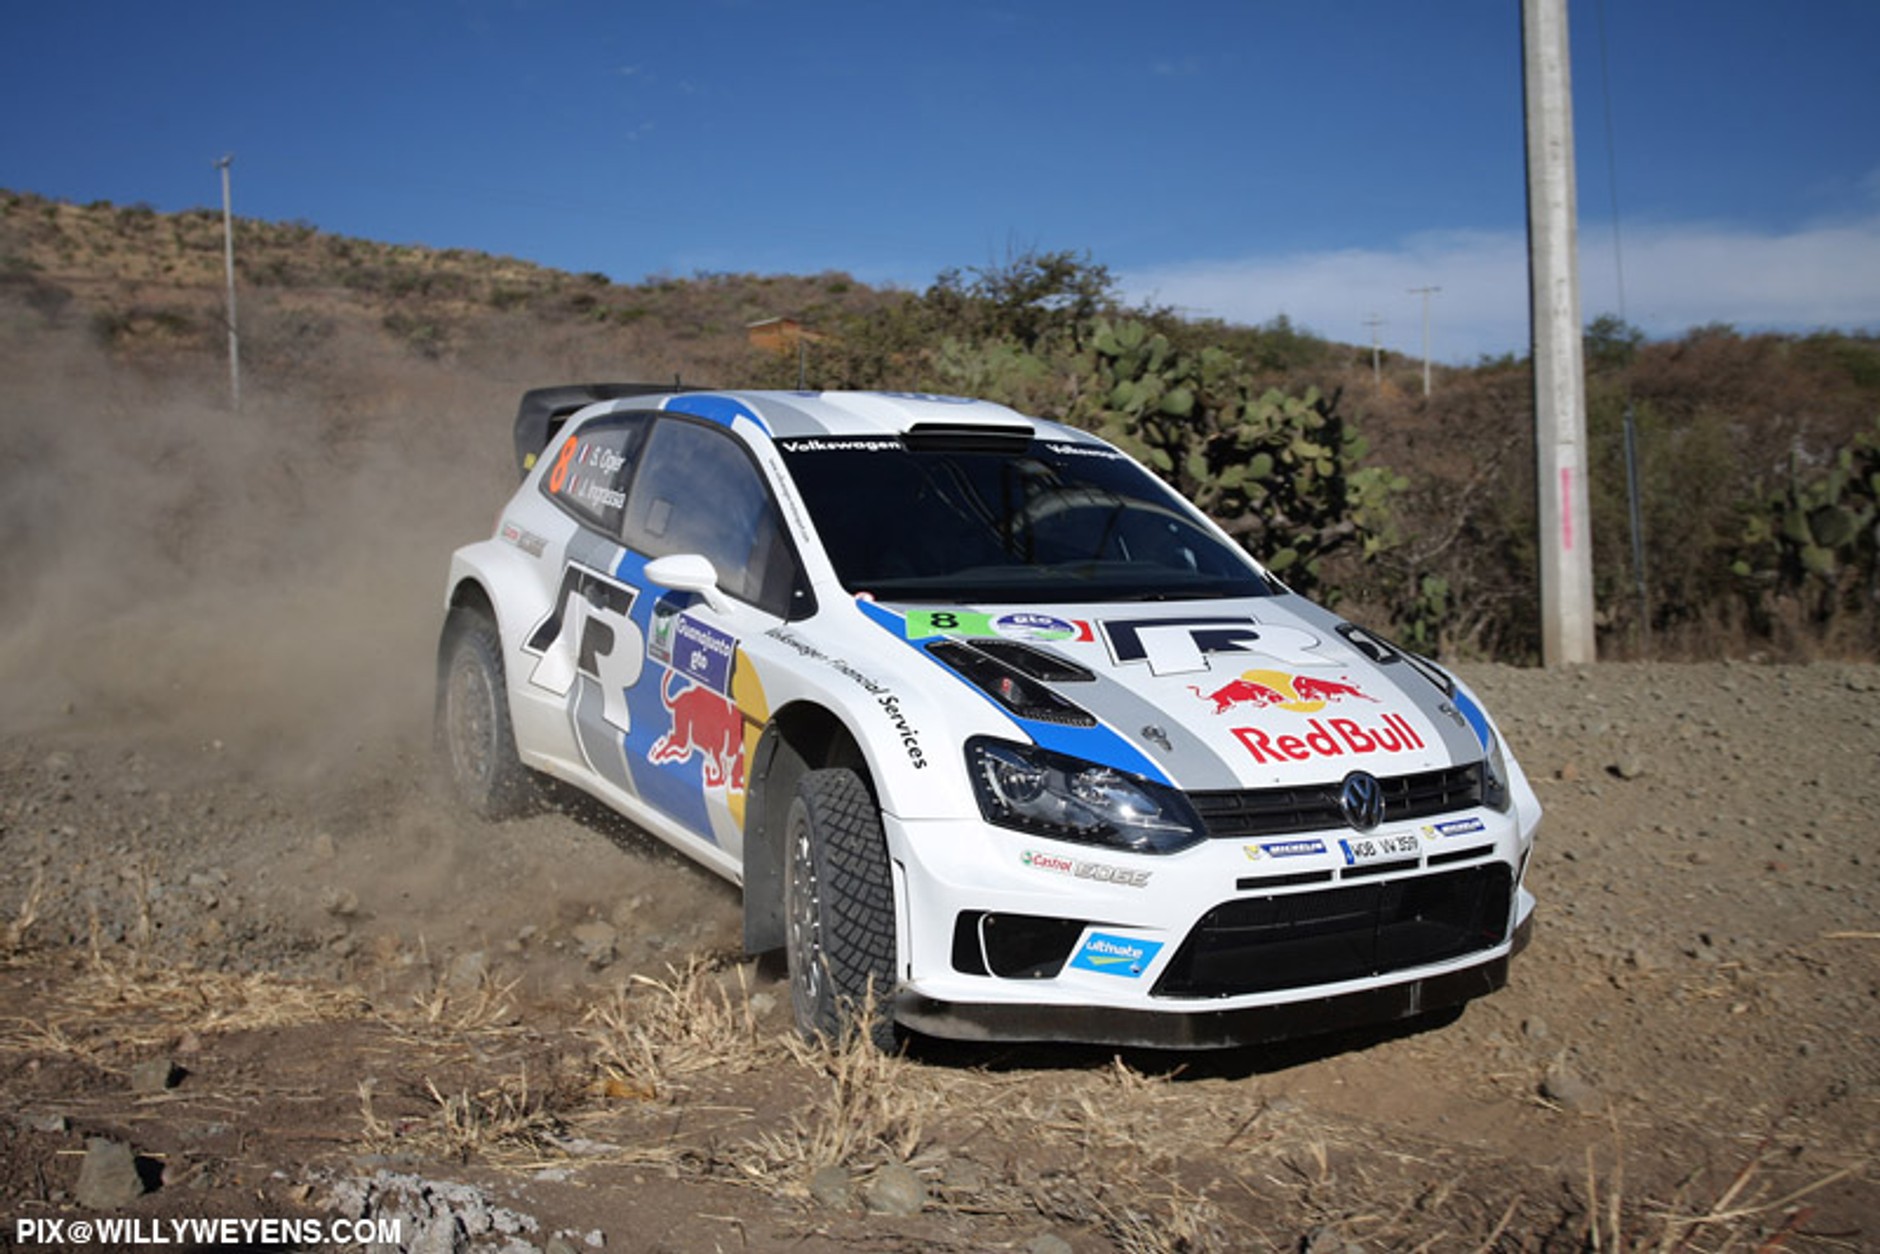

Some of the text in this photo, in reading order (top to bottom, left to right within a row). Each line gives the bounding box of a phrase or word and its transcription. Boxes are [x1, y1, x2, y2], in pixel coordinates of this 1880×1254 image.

[782, 439, 900, 452] Volkswagen
[549, 435, 578, 494] 8
[930, 612, 959, 628] 8
[878, 694, 928, 770] Services
[1032, 853, 1073, 872] Castrol
[1085, 940, 1144, 959] ultimate
